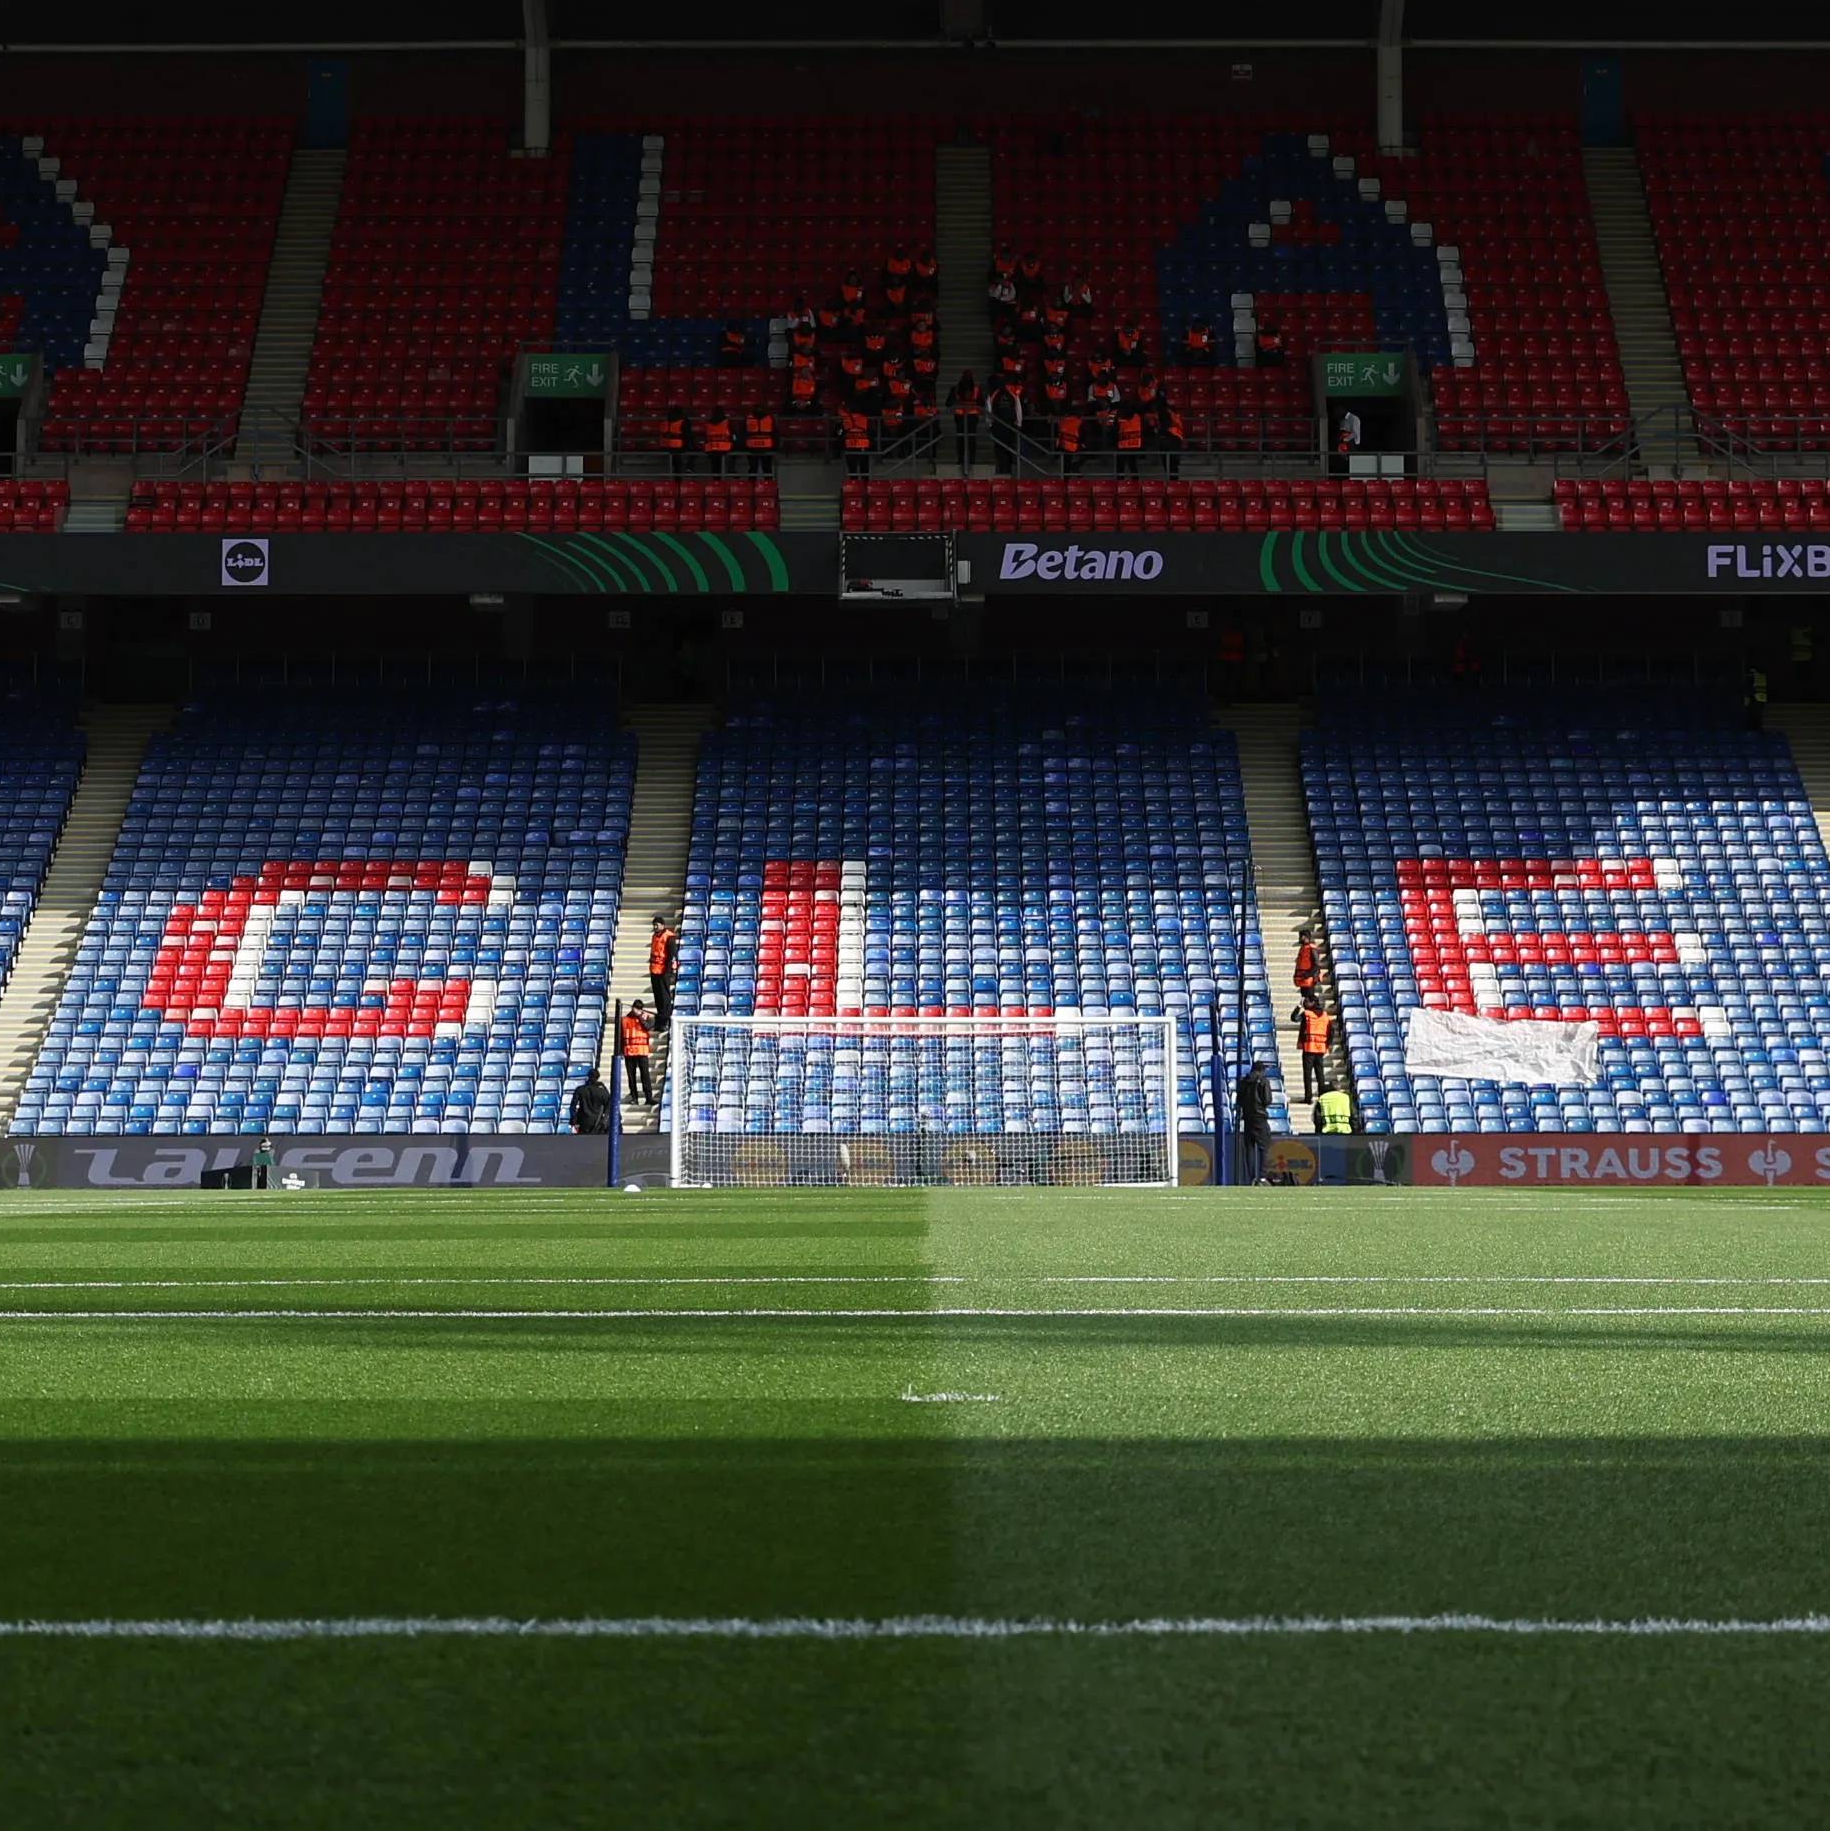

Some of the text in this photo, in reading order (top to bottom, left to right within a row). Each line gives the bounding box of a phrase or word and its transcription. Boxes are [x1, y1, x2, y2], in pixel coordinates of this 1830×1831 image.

[531, 363, 559, 374] FIRE
[1327, 363, 1354, 374] FIRE
[531, 377, 558, 387] EXIT
[1328, 376, 1354, 387] EXIT
[1000, 543, 1164, 580] Betano
[1499, 1146, 1723, 1180] STRAUSS
